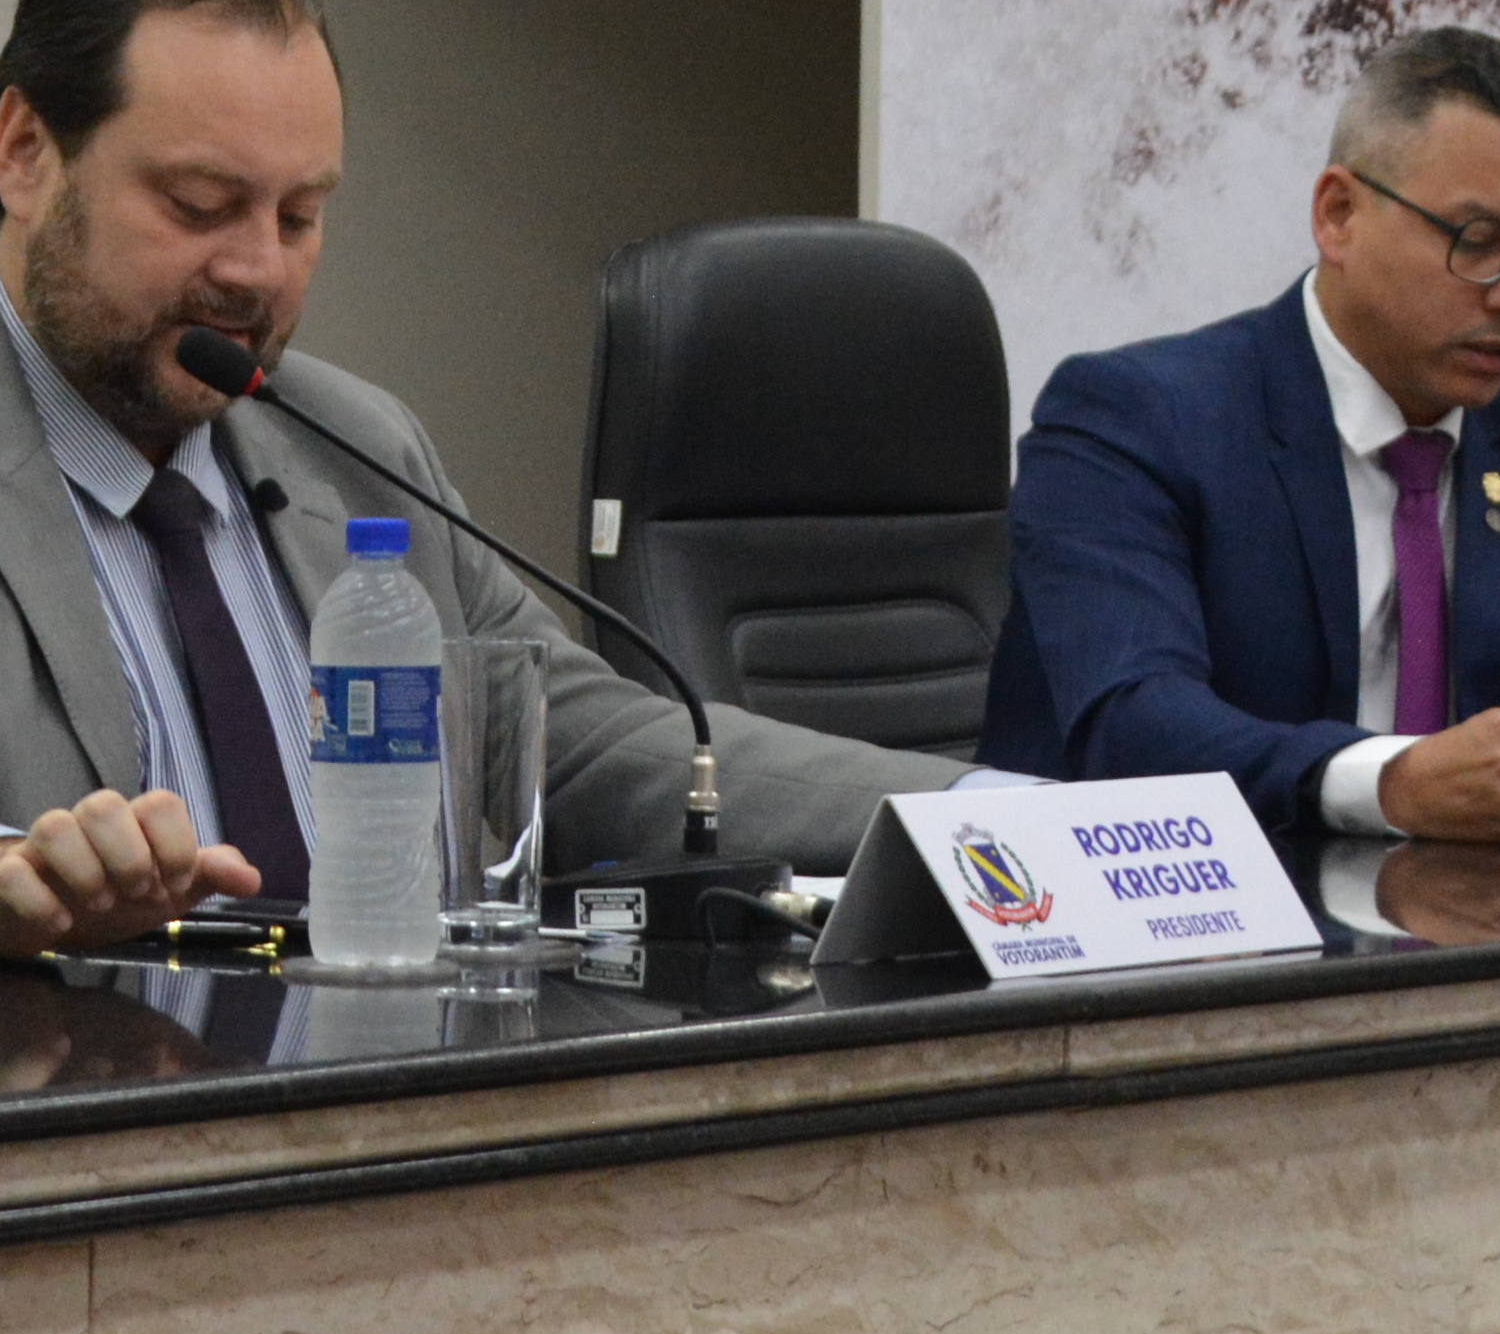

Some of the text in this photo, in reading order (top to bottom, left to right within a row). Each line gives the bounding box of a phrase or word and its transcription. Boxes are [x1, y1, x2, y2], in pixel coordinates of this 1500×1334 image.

[1070, 815, 1214, 858] RODRIGO
[1101, 858, 1238, 901] KRIGUER
[1145, 909, 1247, 942] PRESIDENTE
[996, 944, 1087, 966] VOTORANTIM
